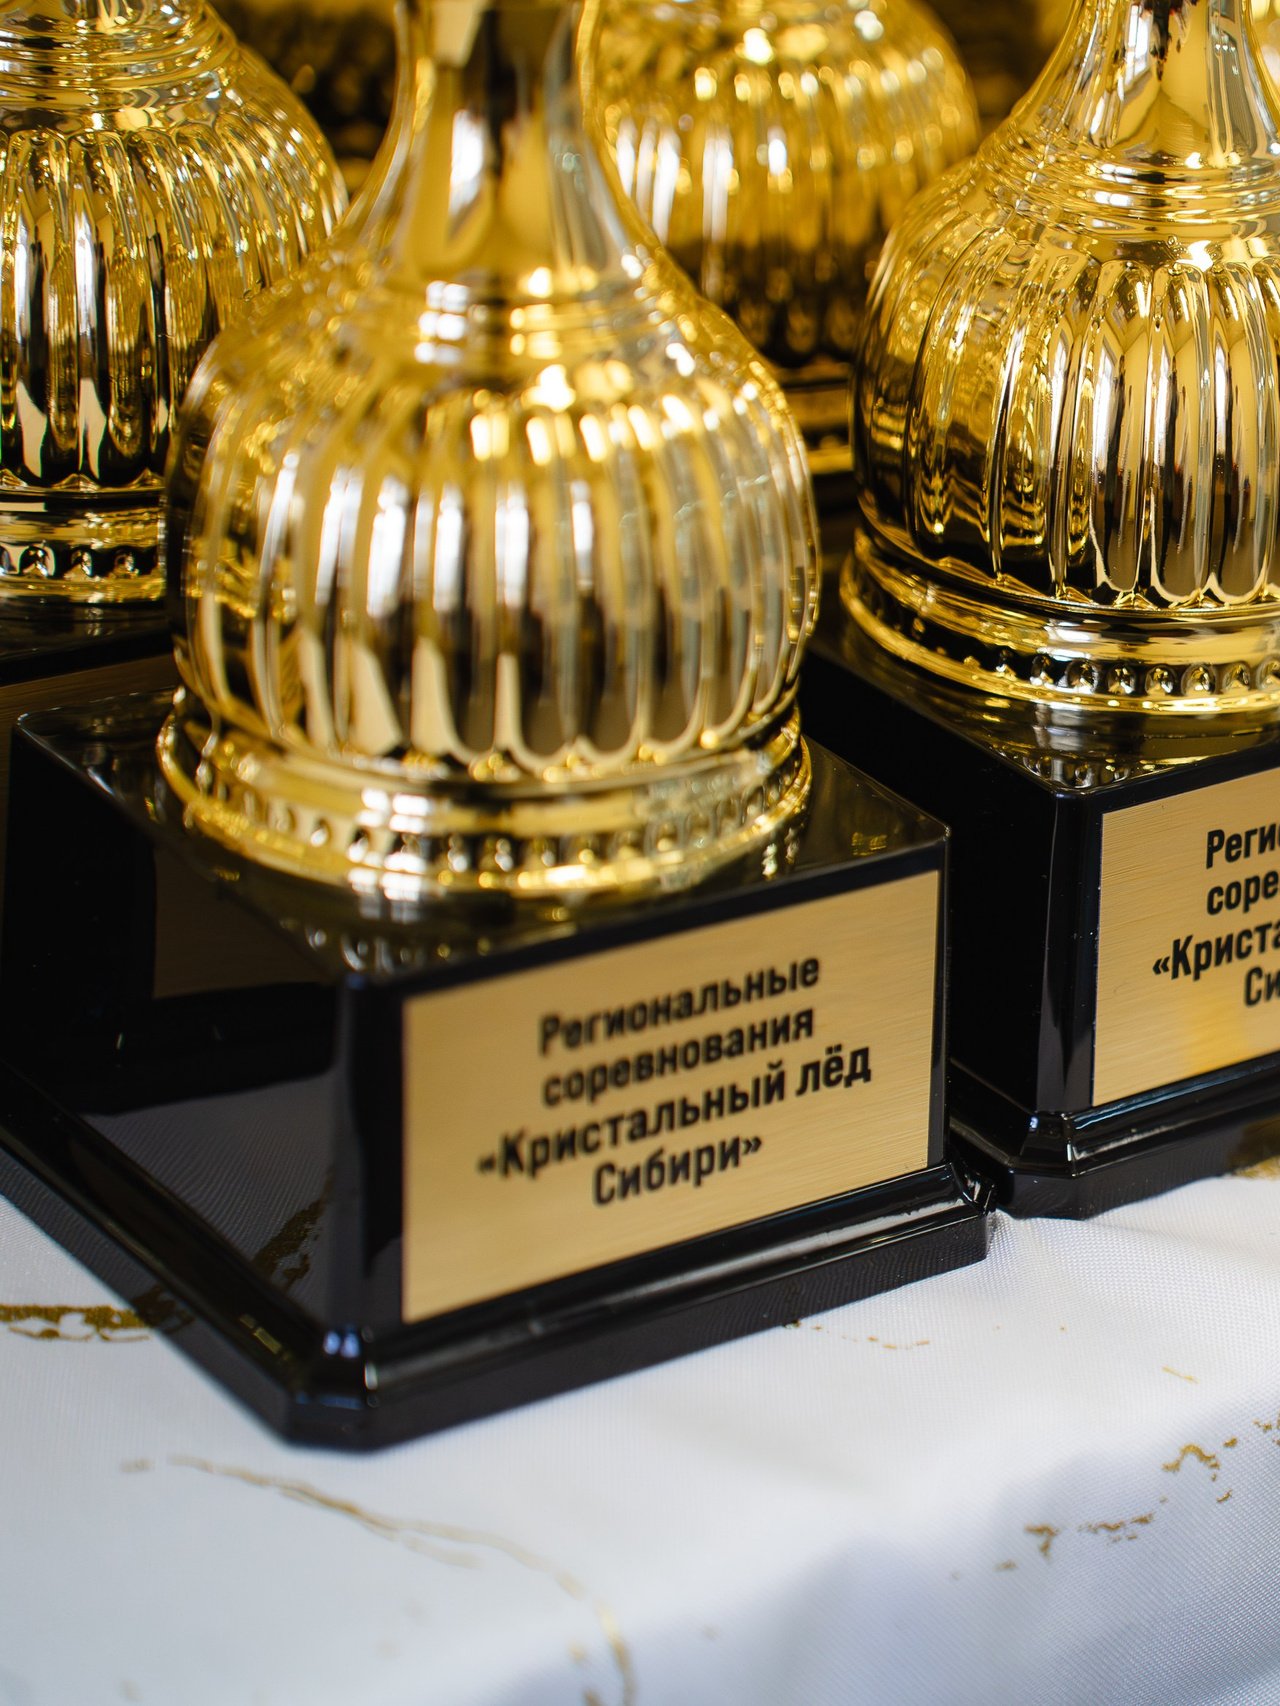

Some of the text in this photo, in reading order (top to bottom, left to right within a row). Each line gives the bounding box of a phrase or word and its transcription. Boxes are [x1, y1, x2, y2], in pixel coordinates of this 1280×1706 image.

[540, 957, 820, 1056] Региональные
[543, 1007, 814, 1107] соревнования
[478, 1044, 871, 1179] «Кристальный лёд
[593, 1136, 762, 1206] Сибири»
